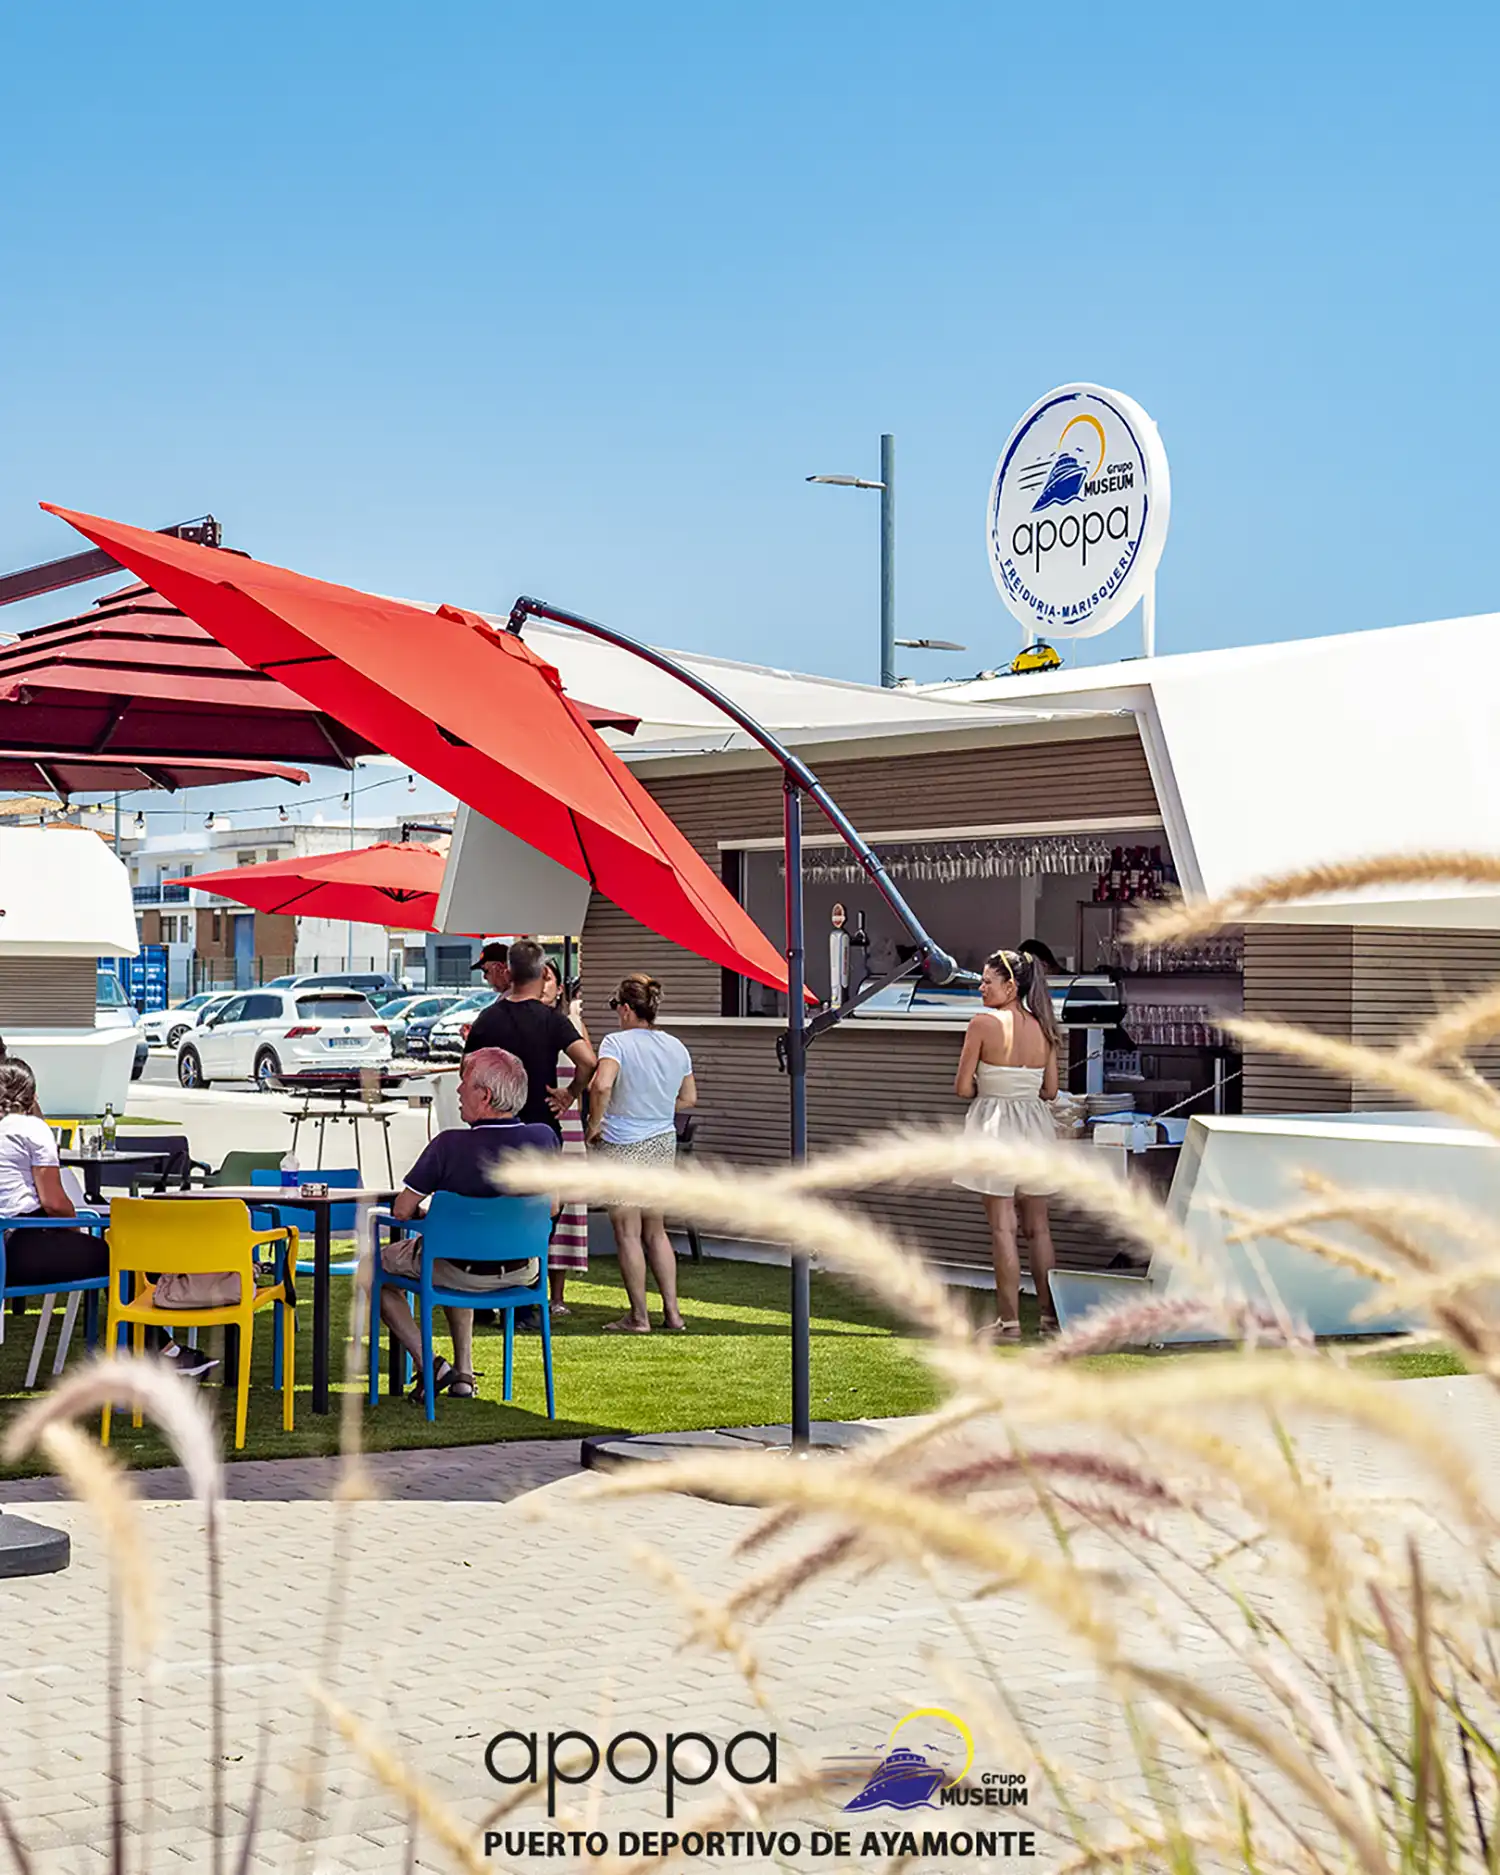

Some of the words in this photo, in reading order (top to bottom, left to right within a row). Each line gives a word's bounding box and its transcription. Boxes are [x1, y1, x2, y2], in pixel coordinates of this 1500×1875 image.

[1107, 461, 1133, 476] Grupo
[1084, 473, 1134, 497] MUSEUM
[1012, 505, 1129, 573] apopa
